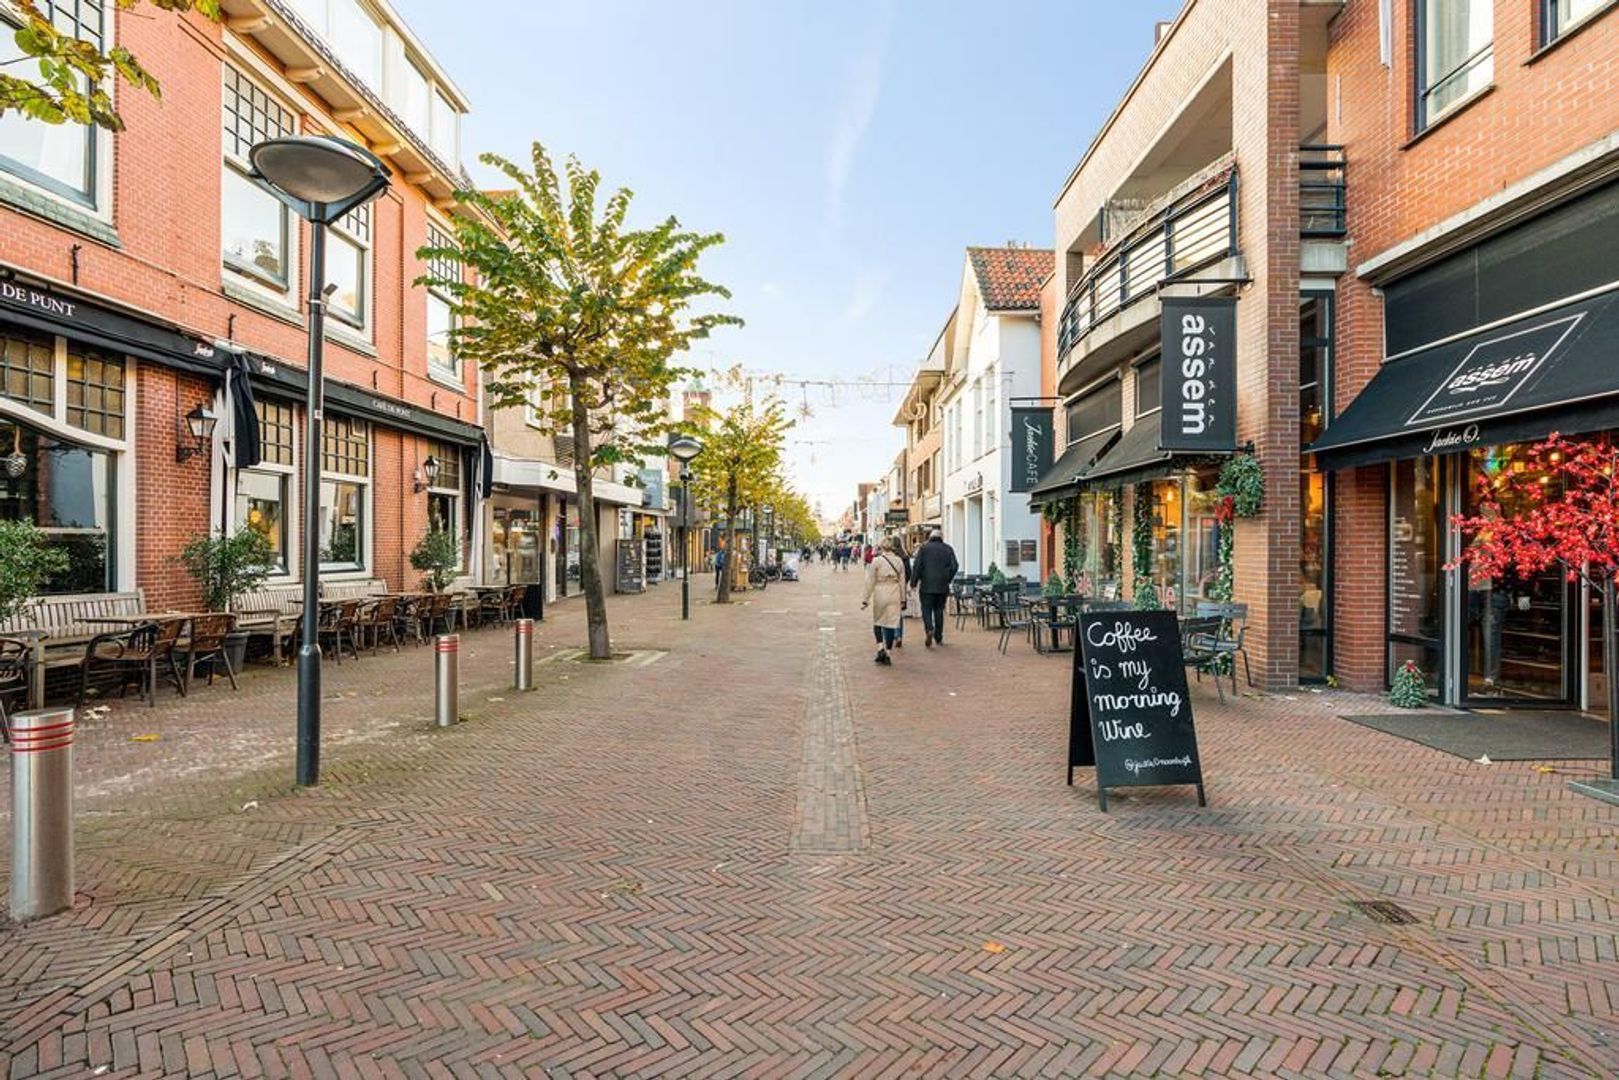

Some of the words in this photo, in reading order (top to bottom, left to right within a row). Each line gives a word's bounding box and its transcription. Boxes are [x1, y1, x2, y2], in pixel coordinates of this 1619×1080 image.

[2, 282, 26, 302] DE
[30, 291, 75, 317] PUNT
[1181, 314, 1205, 435] assem
[1447, 357, 1536, 389] assem
[1423, 428, 1462, 453] Jackie
[1087, 621, 1158, 653] Coffee
[1090, 658, 1112, 680] is
[1118, 660, 1153, 690] my
[1093, 686, 1182, 718] morning
[1098, 719, 1152, 742] Wine
